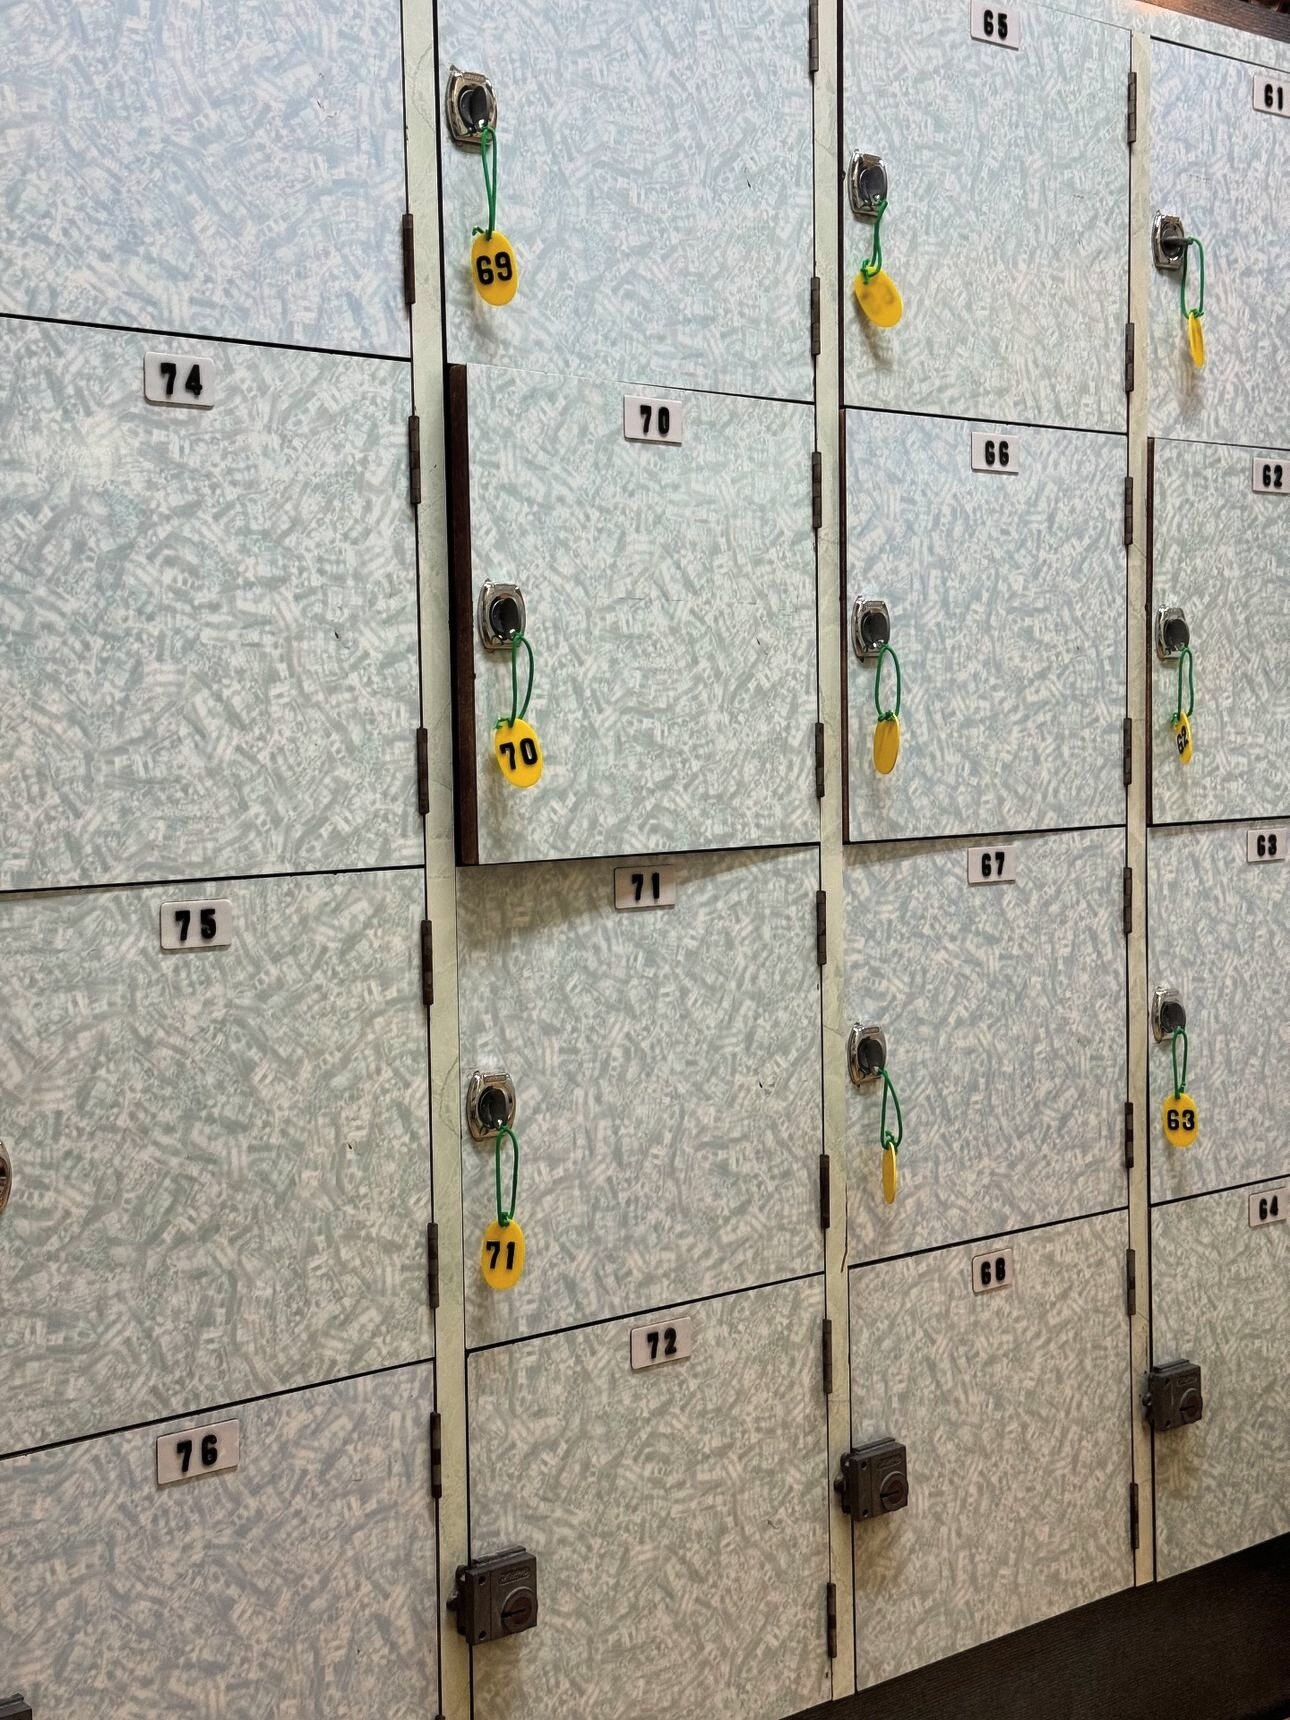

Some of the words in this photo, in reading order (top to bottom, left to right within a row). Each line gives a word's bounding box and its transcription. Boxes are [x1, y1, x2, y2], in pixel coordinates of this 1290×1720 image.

[983, 9, 1008, 40] 65
[1264, 83, 1284, 110] 61
[476, 252, 513, 285] 69
[160, 363, 203, 399] 74
[639, 404, 670, 436] 70
[985, 440, 1009, 467] 66
[1262, 464, 1283, 489] 62
[499, 738, 538, 770] 70
[1257, 834, 1277, 857] 63
[981, 852, 1005, 878] 67
[632, 872, 660, 903] 71
[174, 908, 217, 942] 75
[1167, 1109, 1194, 1131] 63
[1259, 1195, 1279, 1220] 64
[486, 1241, 515, 1270] 71
[980, 1257, 1006, 1285] 68
[647, 1327, 677, 1359] 72
[176, 1434, 218, 1473] 76
